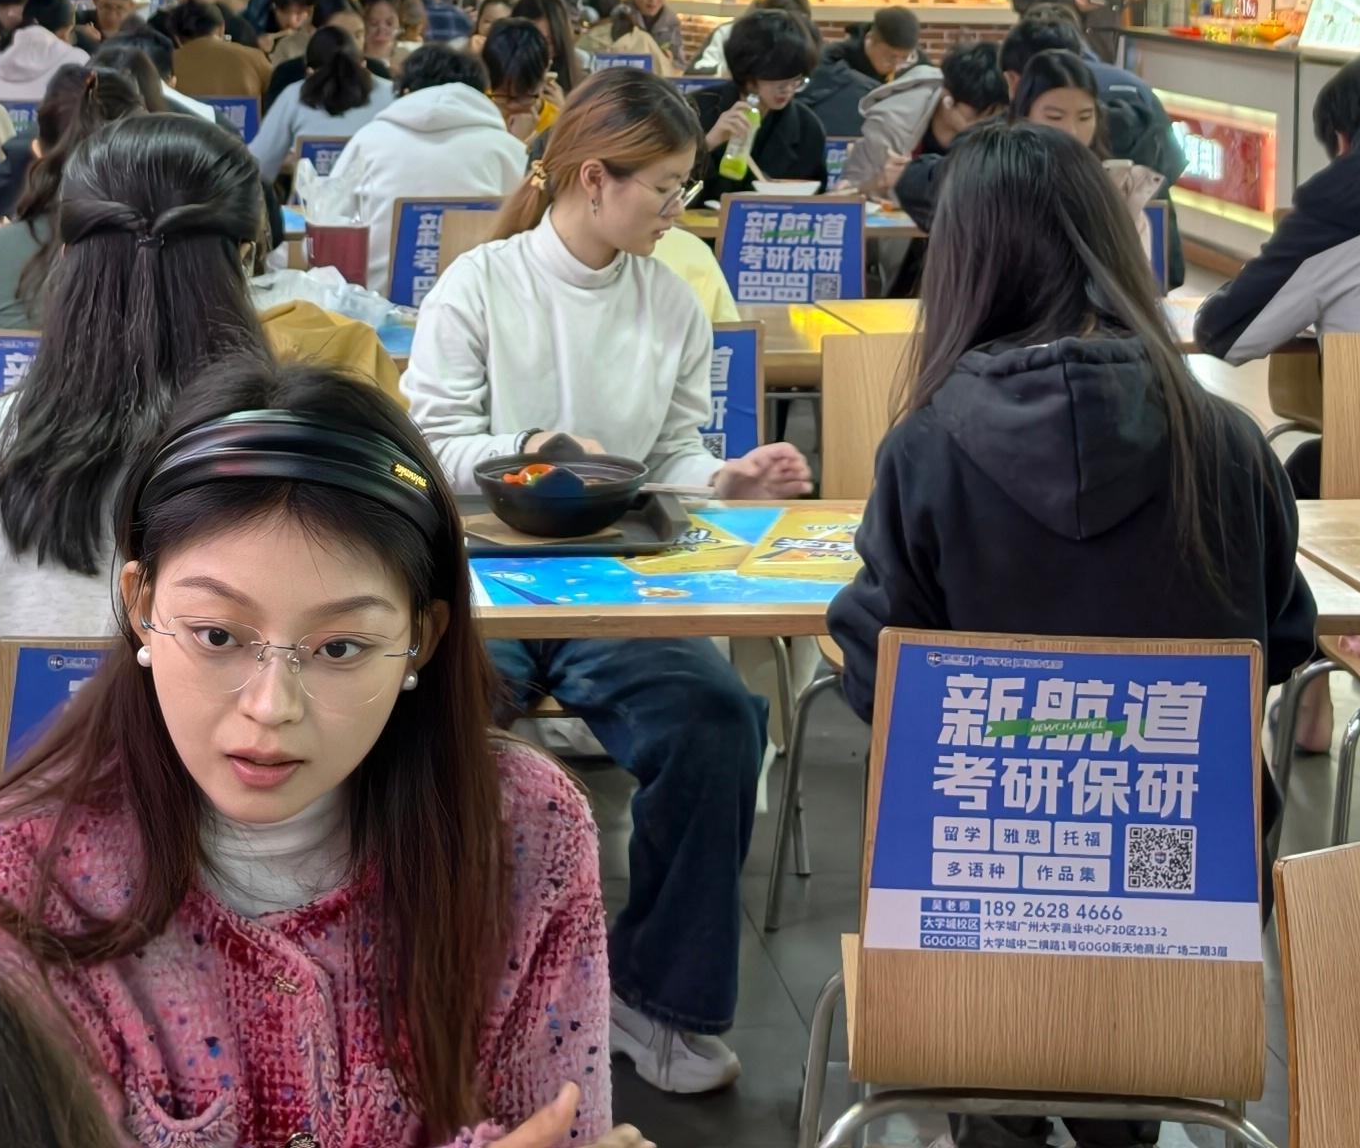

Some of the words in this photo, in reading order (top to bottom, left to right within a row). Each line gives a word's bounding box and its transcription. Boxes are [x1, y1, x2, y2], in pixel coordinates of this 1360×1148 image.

[742, 211, 847, 245] 新航道
[739, 245, 843, 272] 考研保研
[937, 673, 1207, 755] 新航道
[932, 752, 1200, 819] 考研保研
[944, 825, 981, 842] 留学
[1003, 828, 1041, 845] 雅思
[1063, 830, 1101, 847] 托福
[947, 861, 1006, 879] 多语种
[1036, 864, 1096, 883] 作品集
[984, 900, 1016, 917] 189
[1023, 901, 1069, 918] 2628
[1076, 903, 1123, 921] 4666
[923, 917, 979, 931] 大学城校区
[922, 935, 978, 949] GOGO校区
